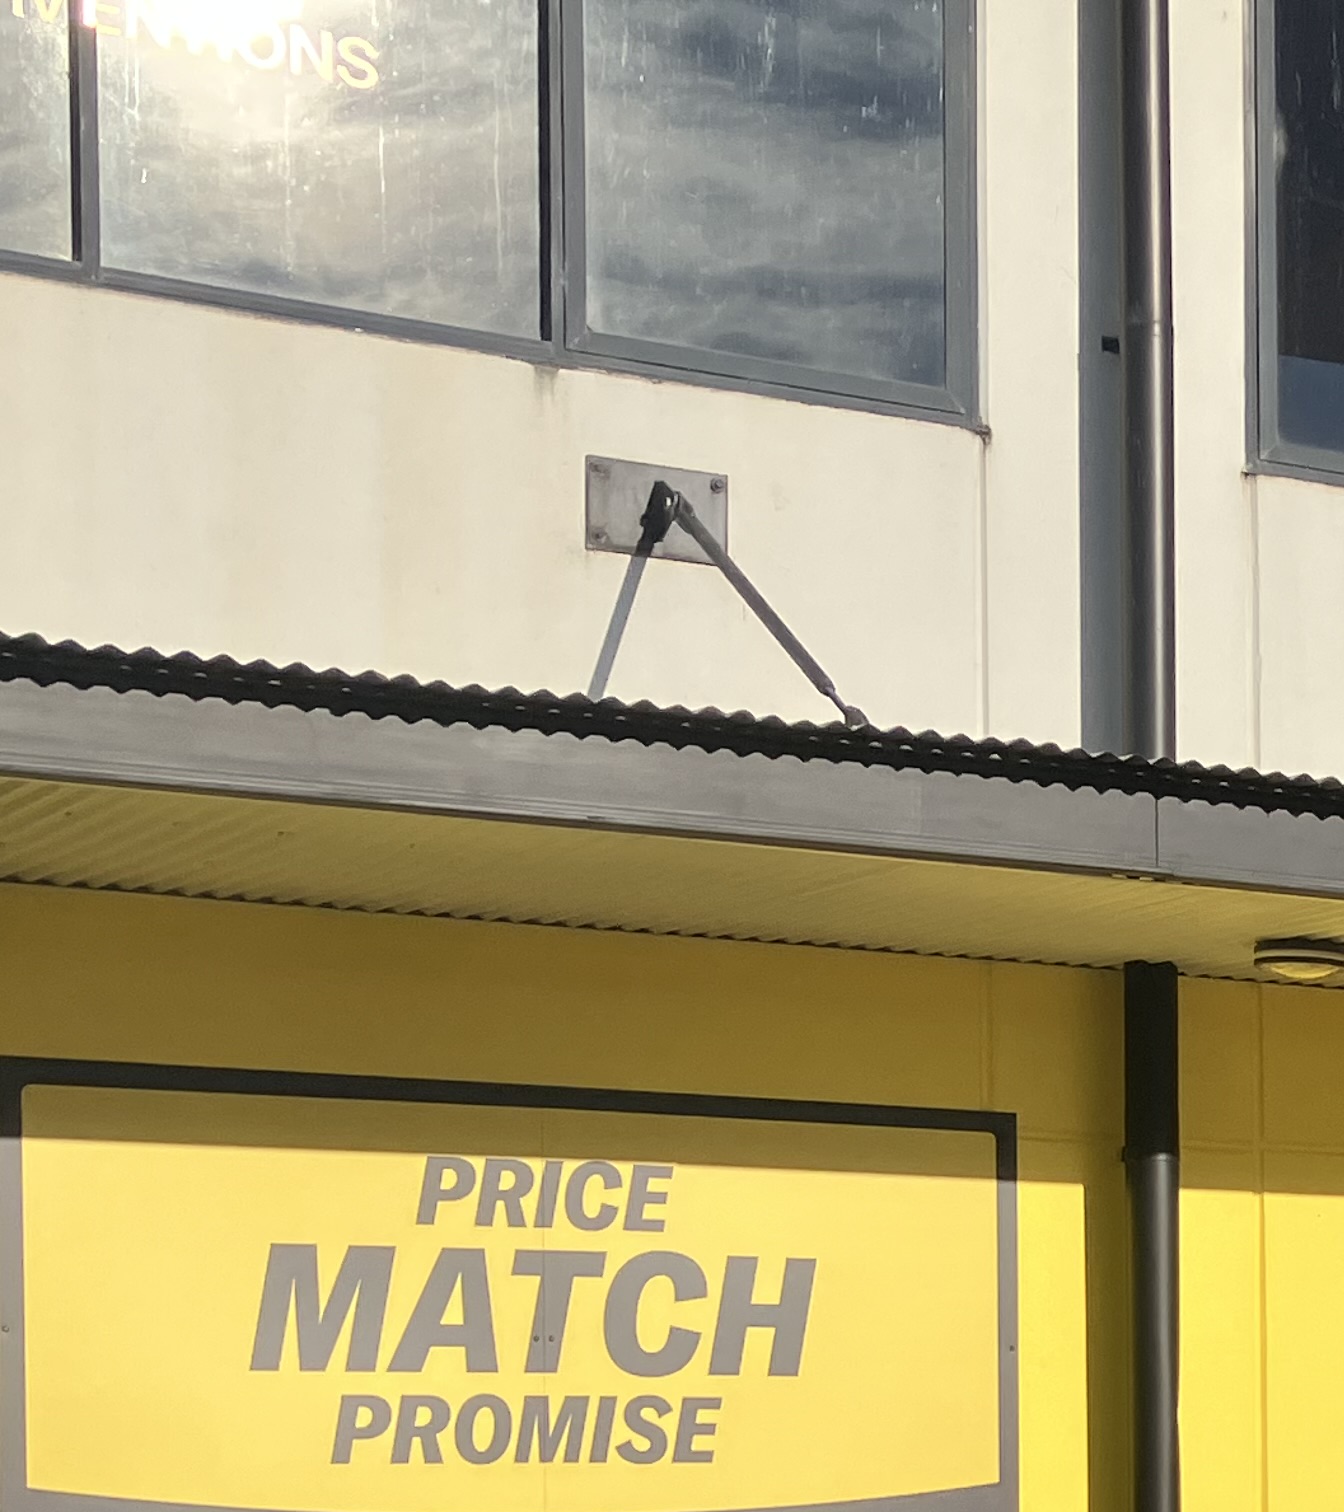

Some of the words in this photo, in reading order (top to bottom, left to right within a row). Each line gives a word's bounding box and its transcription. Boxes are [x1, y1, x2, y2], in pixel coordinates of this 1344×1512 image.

[416, 1156, 673, 1232] PRICE
[250, 1243, 817, 1377] MATCH
[331, 1393, 721, 1464] PROMISE
